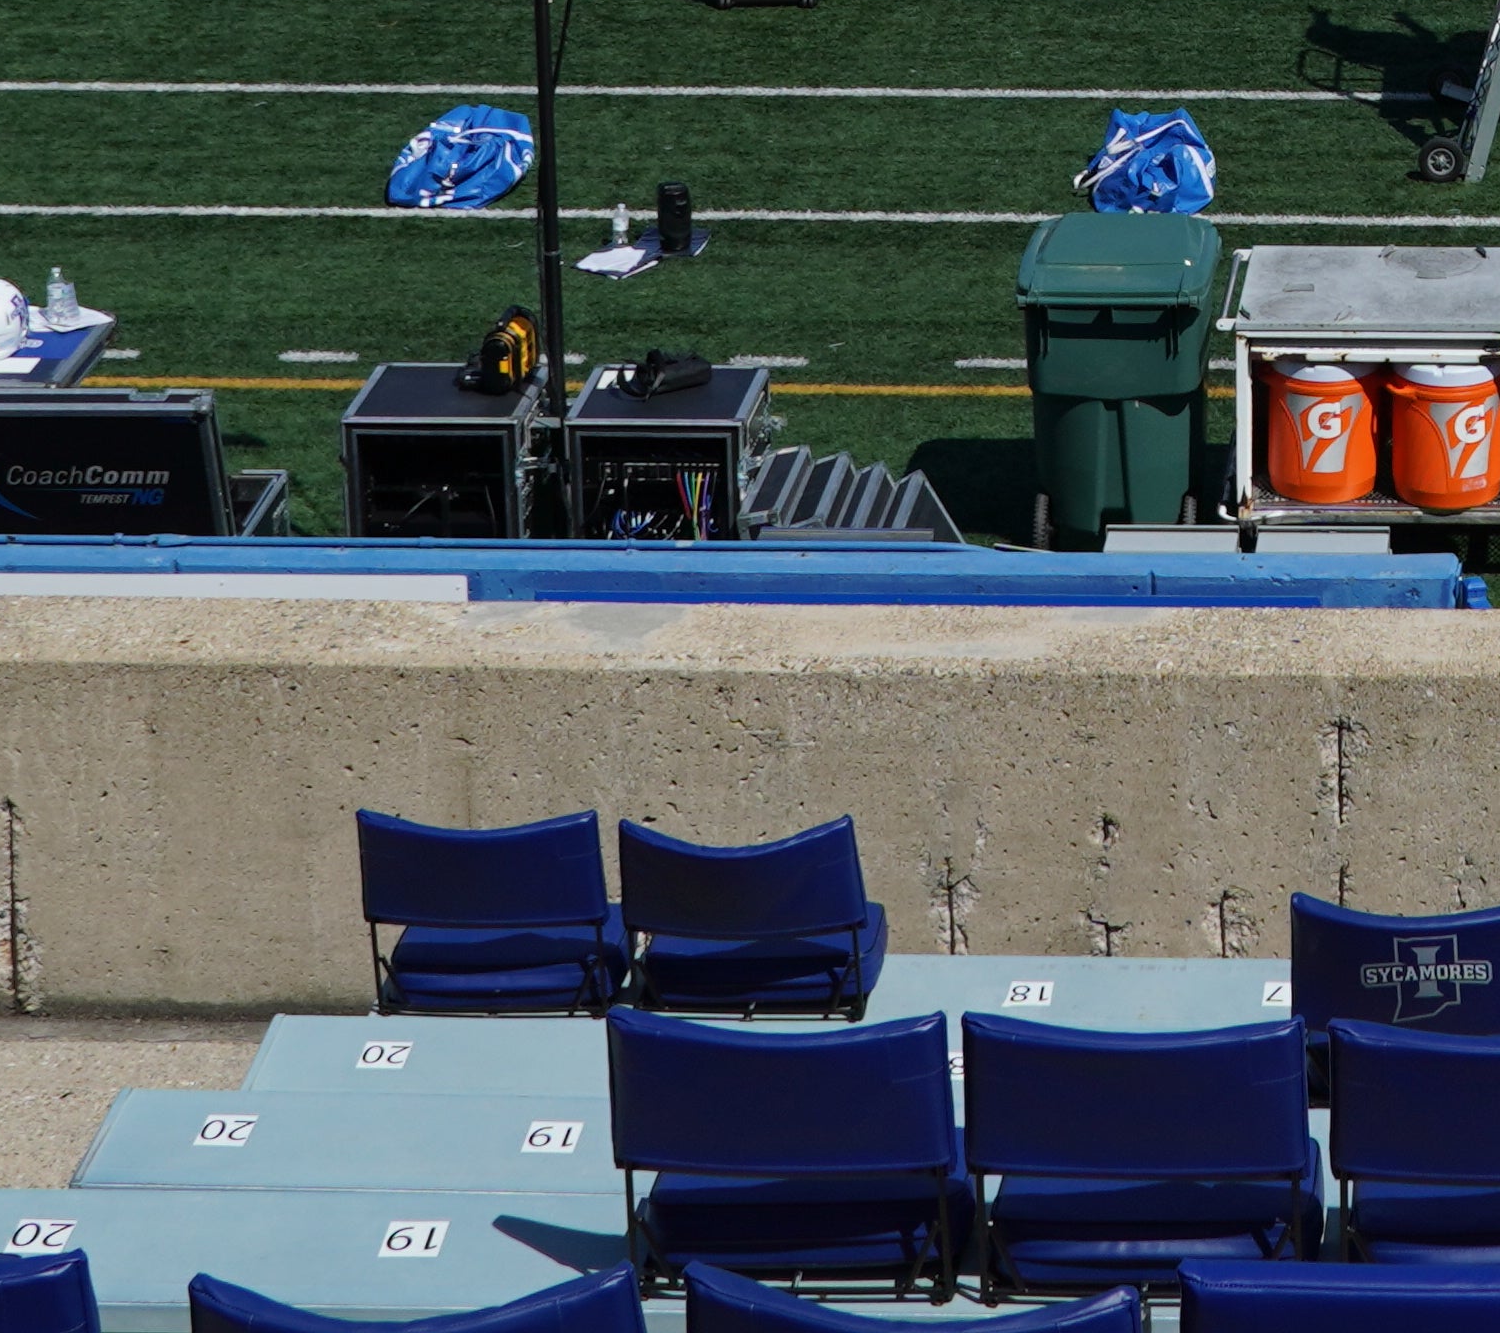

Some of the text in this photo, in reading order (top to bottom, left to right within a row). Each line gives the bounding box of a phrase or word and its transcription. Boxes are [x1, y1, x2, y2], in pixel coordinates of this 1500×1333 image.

[1307, 400, 1341, 440] G
[1454, 403, 1486, 444] G
[7, 465, 170, 485] CoachComm
[80, 489, 164, 504] TEMPEST NG
[1365, 963, 1489, 985] SYCAMORES
[1011, 985, 1046, 1002] 18
[362, 1045, 410, 1064] 20
[201, 1119, 256, 1141] 20
[529, 1126, 573, 1147] 19
[11, 1222, 74, 1248] 20
[387, 1227, 438, 1251] 19
